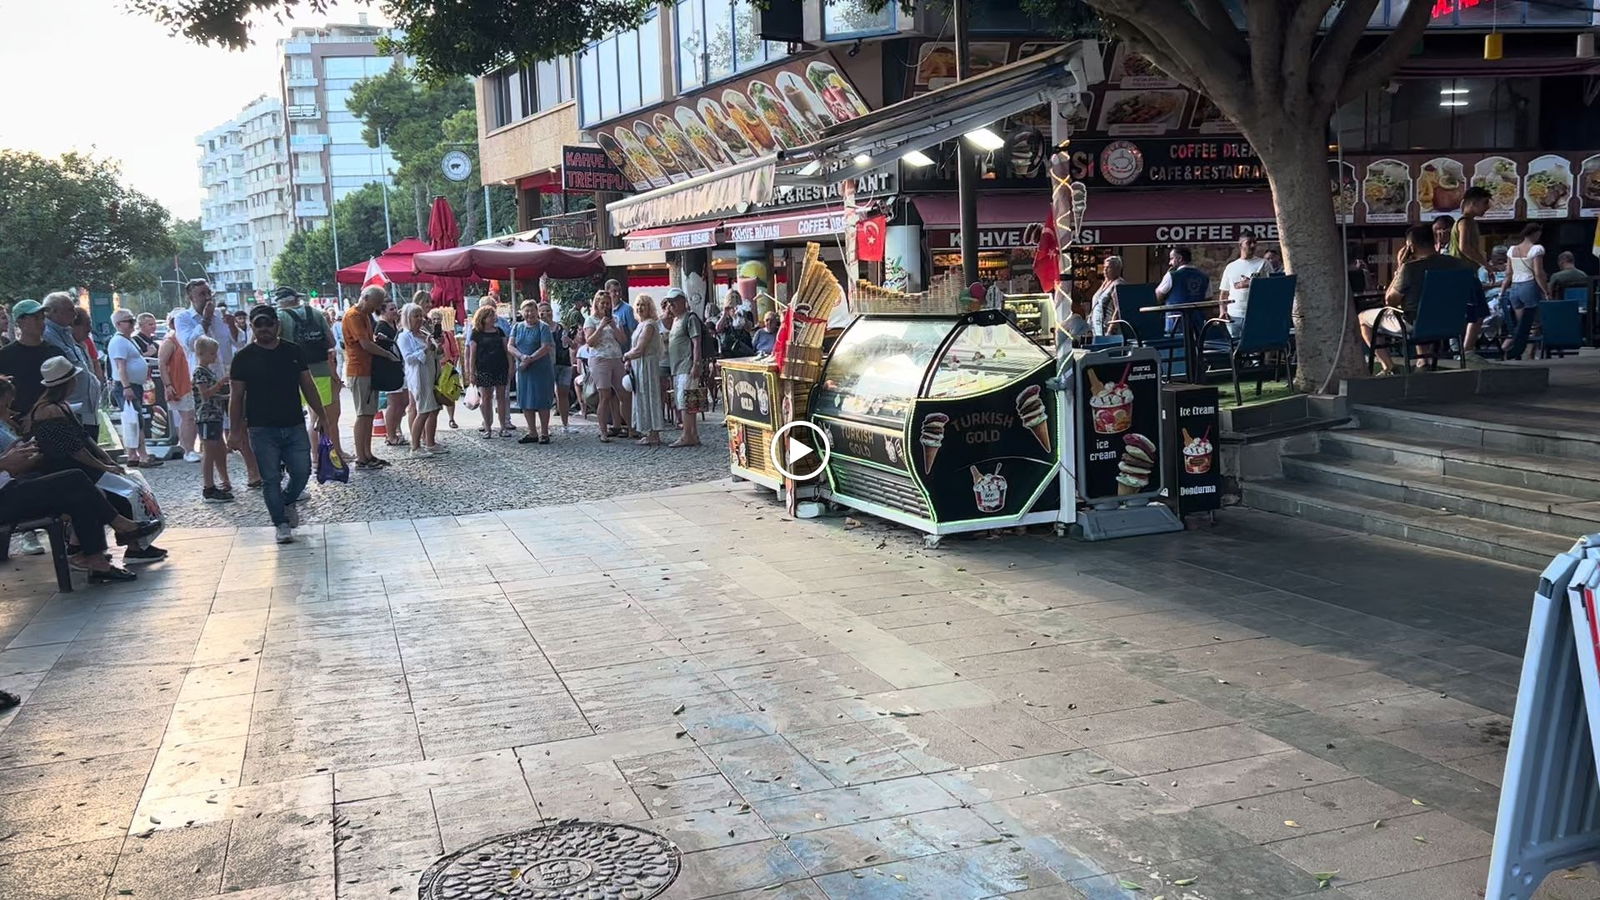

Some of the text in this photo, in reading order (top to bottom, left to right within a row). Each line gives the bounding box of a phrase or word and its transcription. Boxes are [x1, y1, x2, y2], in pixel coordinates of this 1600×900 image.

[1169, 143, 1217, 159] COFFEE
[565, 151, 606, 169] KAHVE
[798, 217, 828, 234] COFFEE
[1156, 224, 1233, 241] COFFEE
[950, 231, 1020, 247] KHVE
[1179, 405, 1215, 417] Ice Cream
[951, 411, 1014, 432] TURKISH
[840, 424, 875, 445] TURKISH
[966, 429, 1001, 444] GOLD
[848, 441, 872, 458] GOLD
[1096, 439, 1109, 449] ice
[1089, 450, 1117, 461] cream
[1180, 484, 1217, 497] Dondurma
